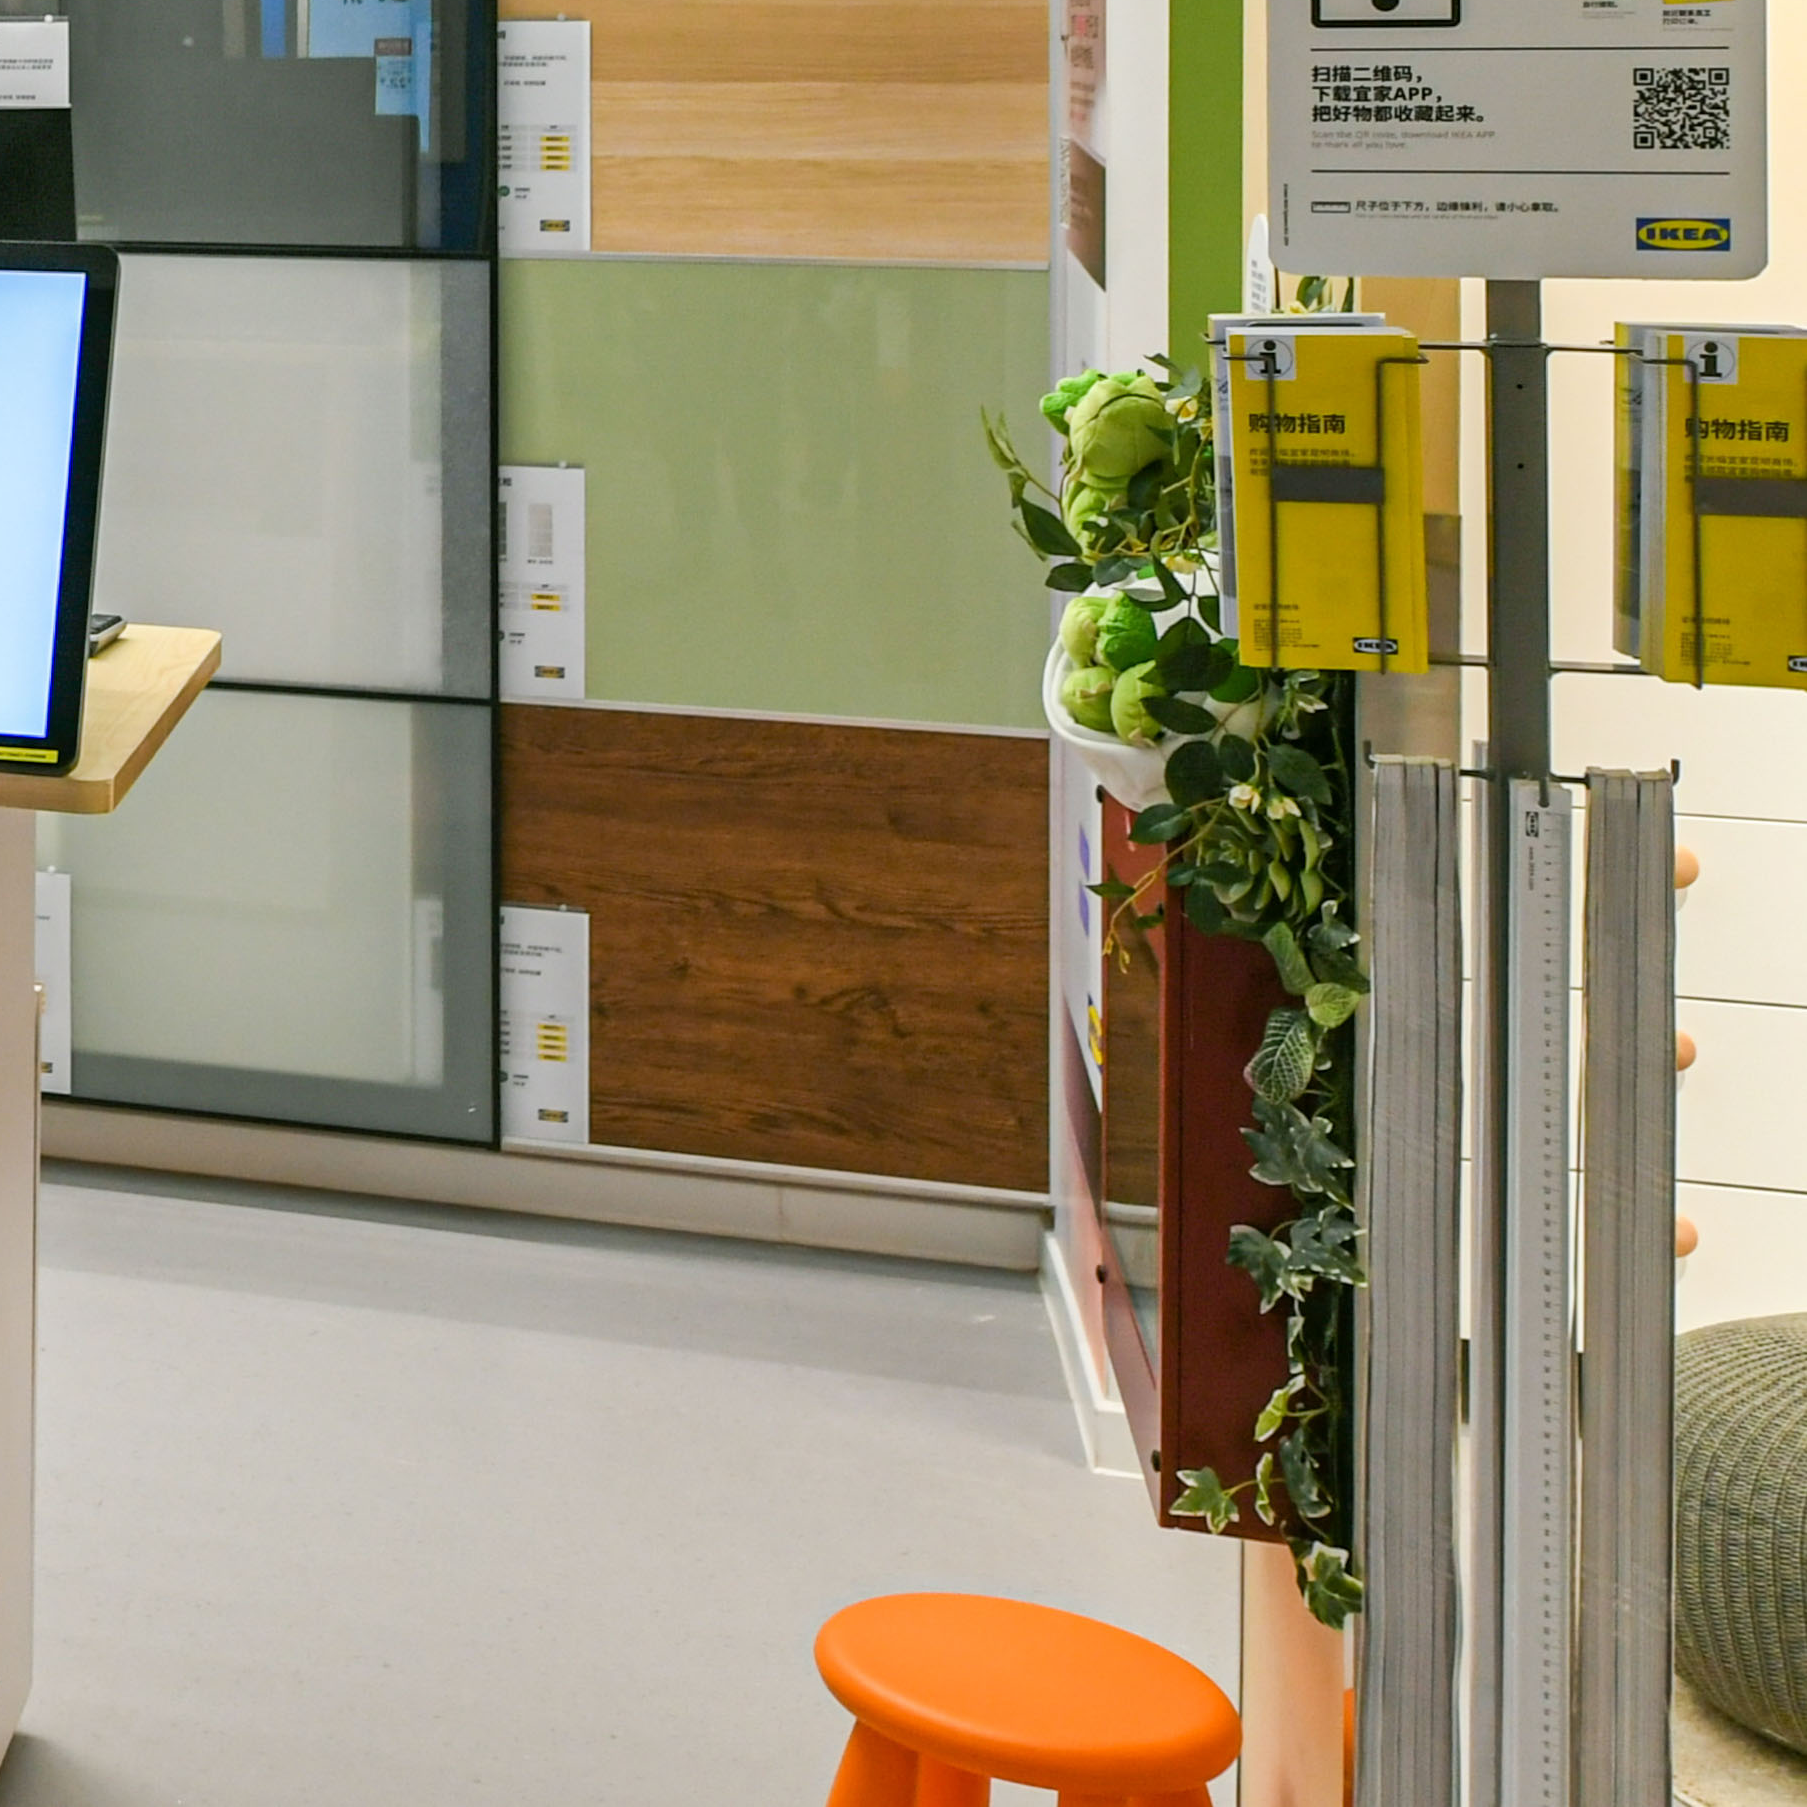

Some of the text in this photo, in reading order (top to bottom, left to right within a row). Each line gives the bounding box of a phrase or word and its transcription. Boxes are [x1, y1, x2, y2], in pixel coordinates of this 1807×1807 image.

[1312, 65, 1423, 83] 扫描二维码，
[1312, 85, 1442, 103] 下载宜家APP，
[1312, 105, 1485, 123] 把好物都收藏起来。
[1646, 227, 1723, 242] IKEA
